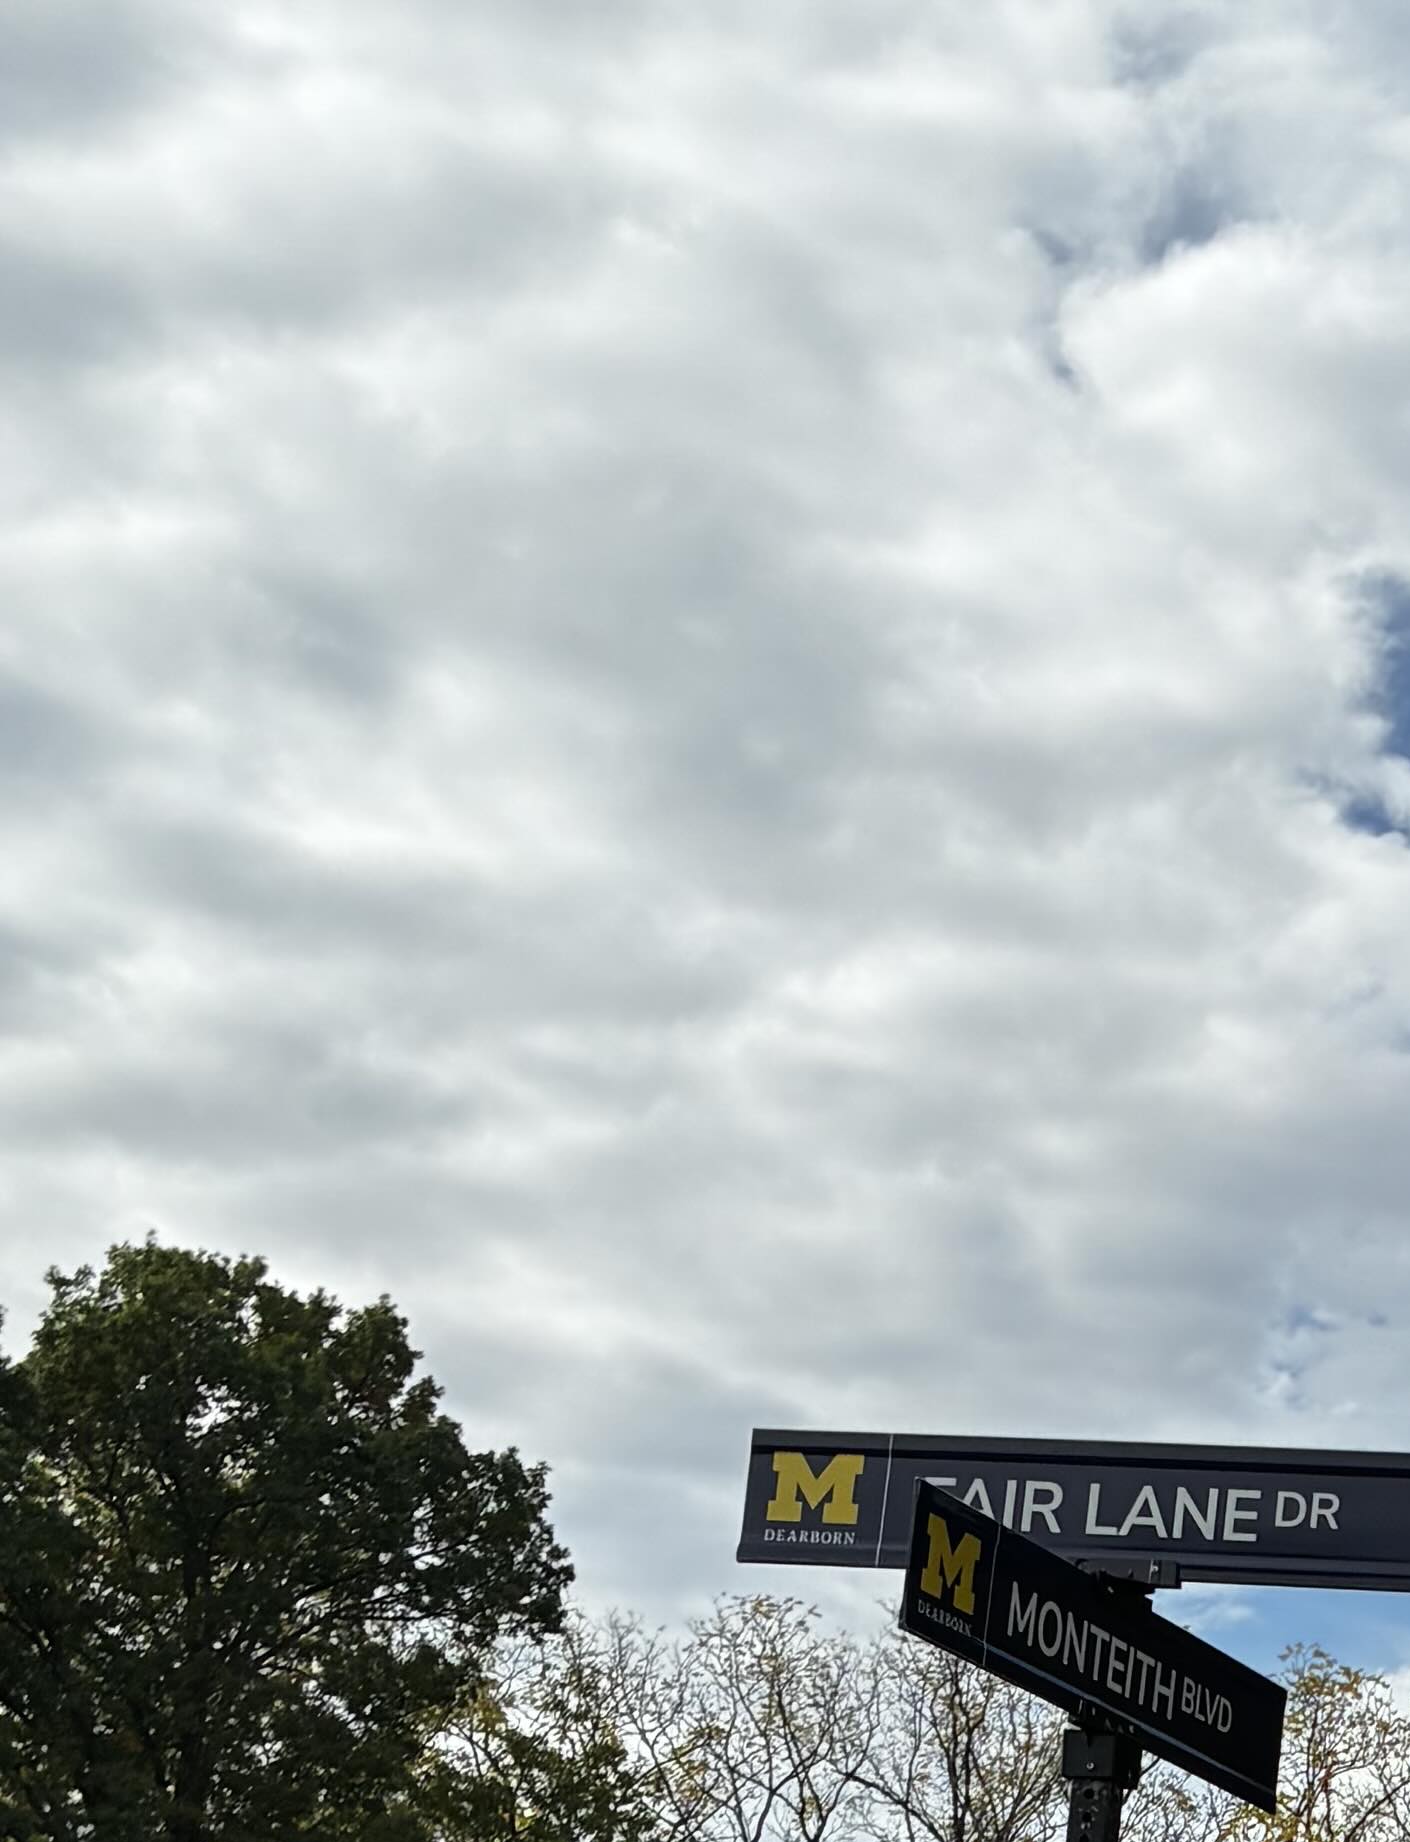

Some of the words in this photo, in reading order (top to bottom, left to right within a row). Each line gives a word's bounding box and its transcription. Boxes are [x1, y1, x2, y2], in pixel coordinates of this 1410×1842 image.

[766, 1451, 865, 1525] M
[1085, 1483, 1262, 1542] LANE
[1274, 1490, 1340, 1530] DR
[764, 1528, 856, 1546] DEARBORN
[920, 1512, 981, 1616] M
[1007, 1581, 1176, 1721] MONTEITH
[1181, 1676, 1232, 1733] BLVD
